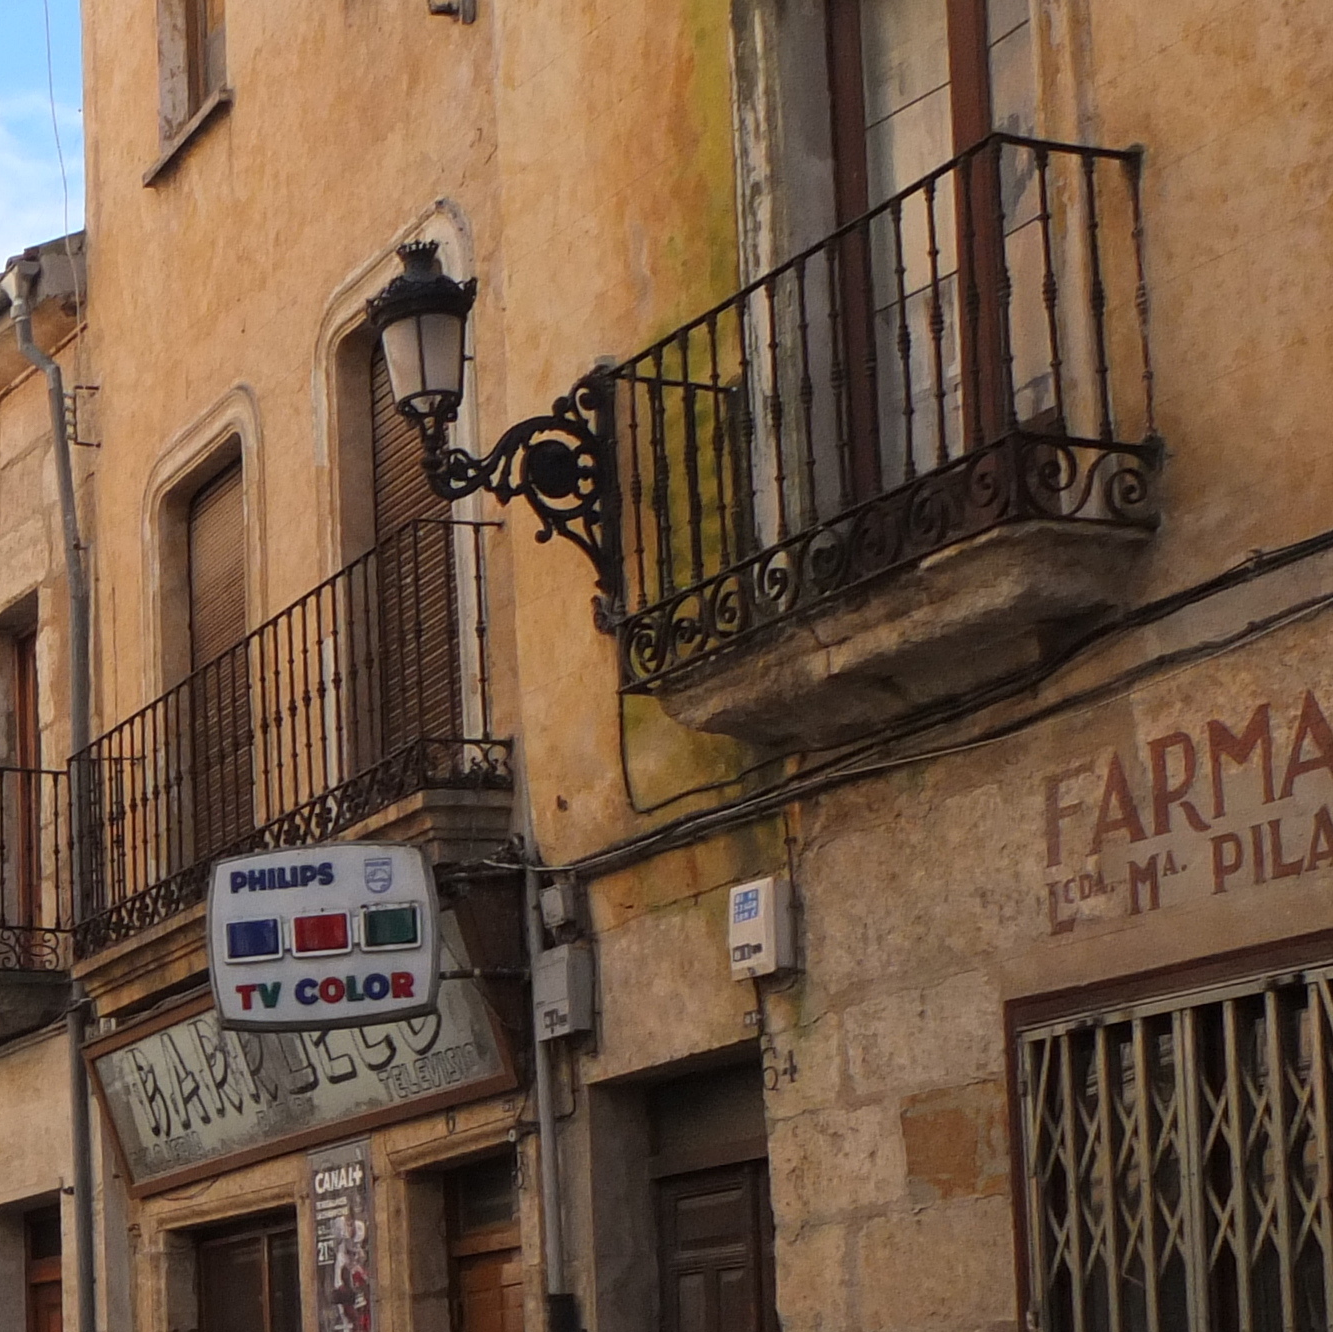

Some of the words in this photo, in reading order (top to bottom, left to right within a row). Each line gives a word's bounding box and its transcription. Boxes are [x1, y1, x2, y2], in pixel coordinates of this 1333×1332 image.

[1044, 689, 1333, 867] FARMA
[1207, 804, 1333, 895] PILA
[230, 862, 334, 893] PHILIPS
[236, 981, 281, 1010] TV
[295, 971, 415, 1005] COLOR
[315, 1164, 363, 1194] CANAL+
